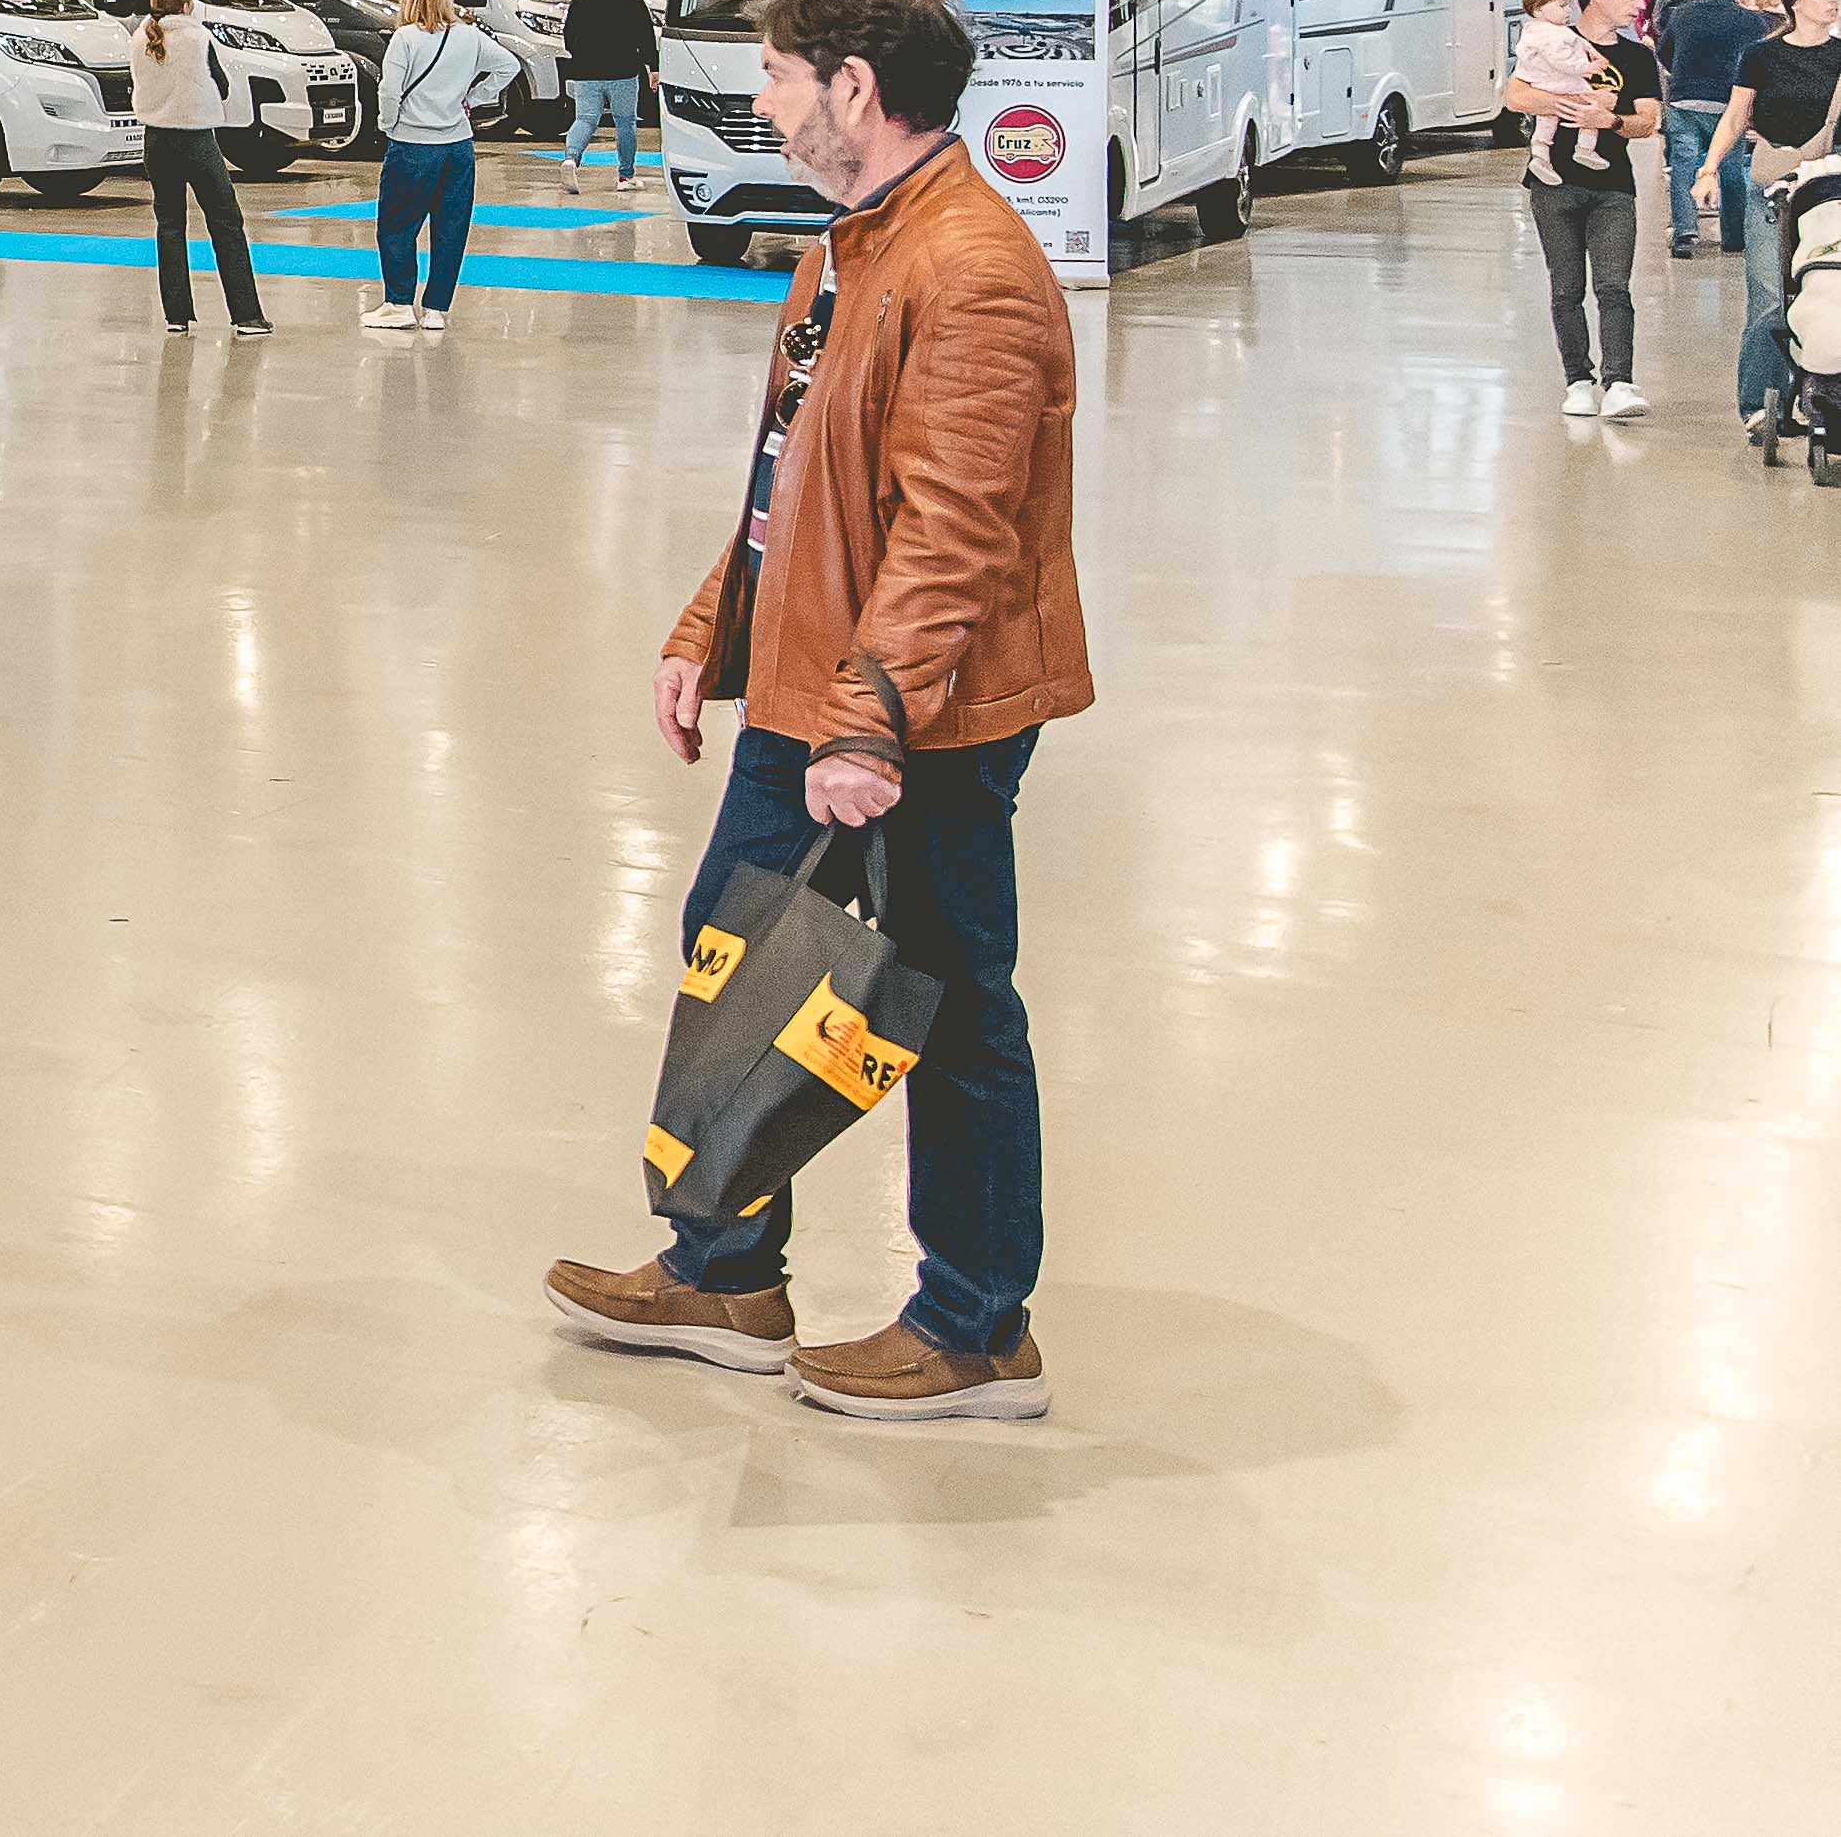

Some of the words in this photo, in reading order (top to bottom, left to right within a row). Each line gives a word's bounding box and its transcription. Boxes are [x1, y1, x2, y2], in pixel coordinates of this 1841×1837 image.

[1033, 80, 1044, 88] tu
[1046, 80, 1085, 88] servicio
[997, 134, 1032, 150] Cruz
[1037, 196, 1069, 204] 03290
